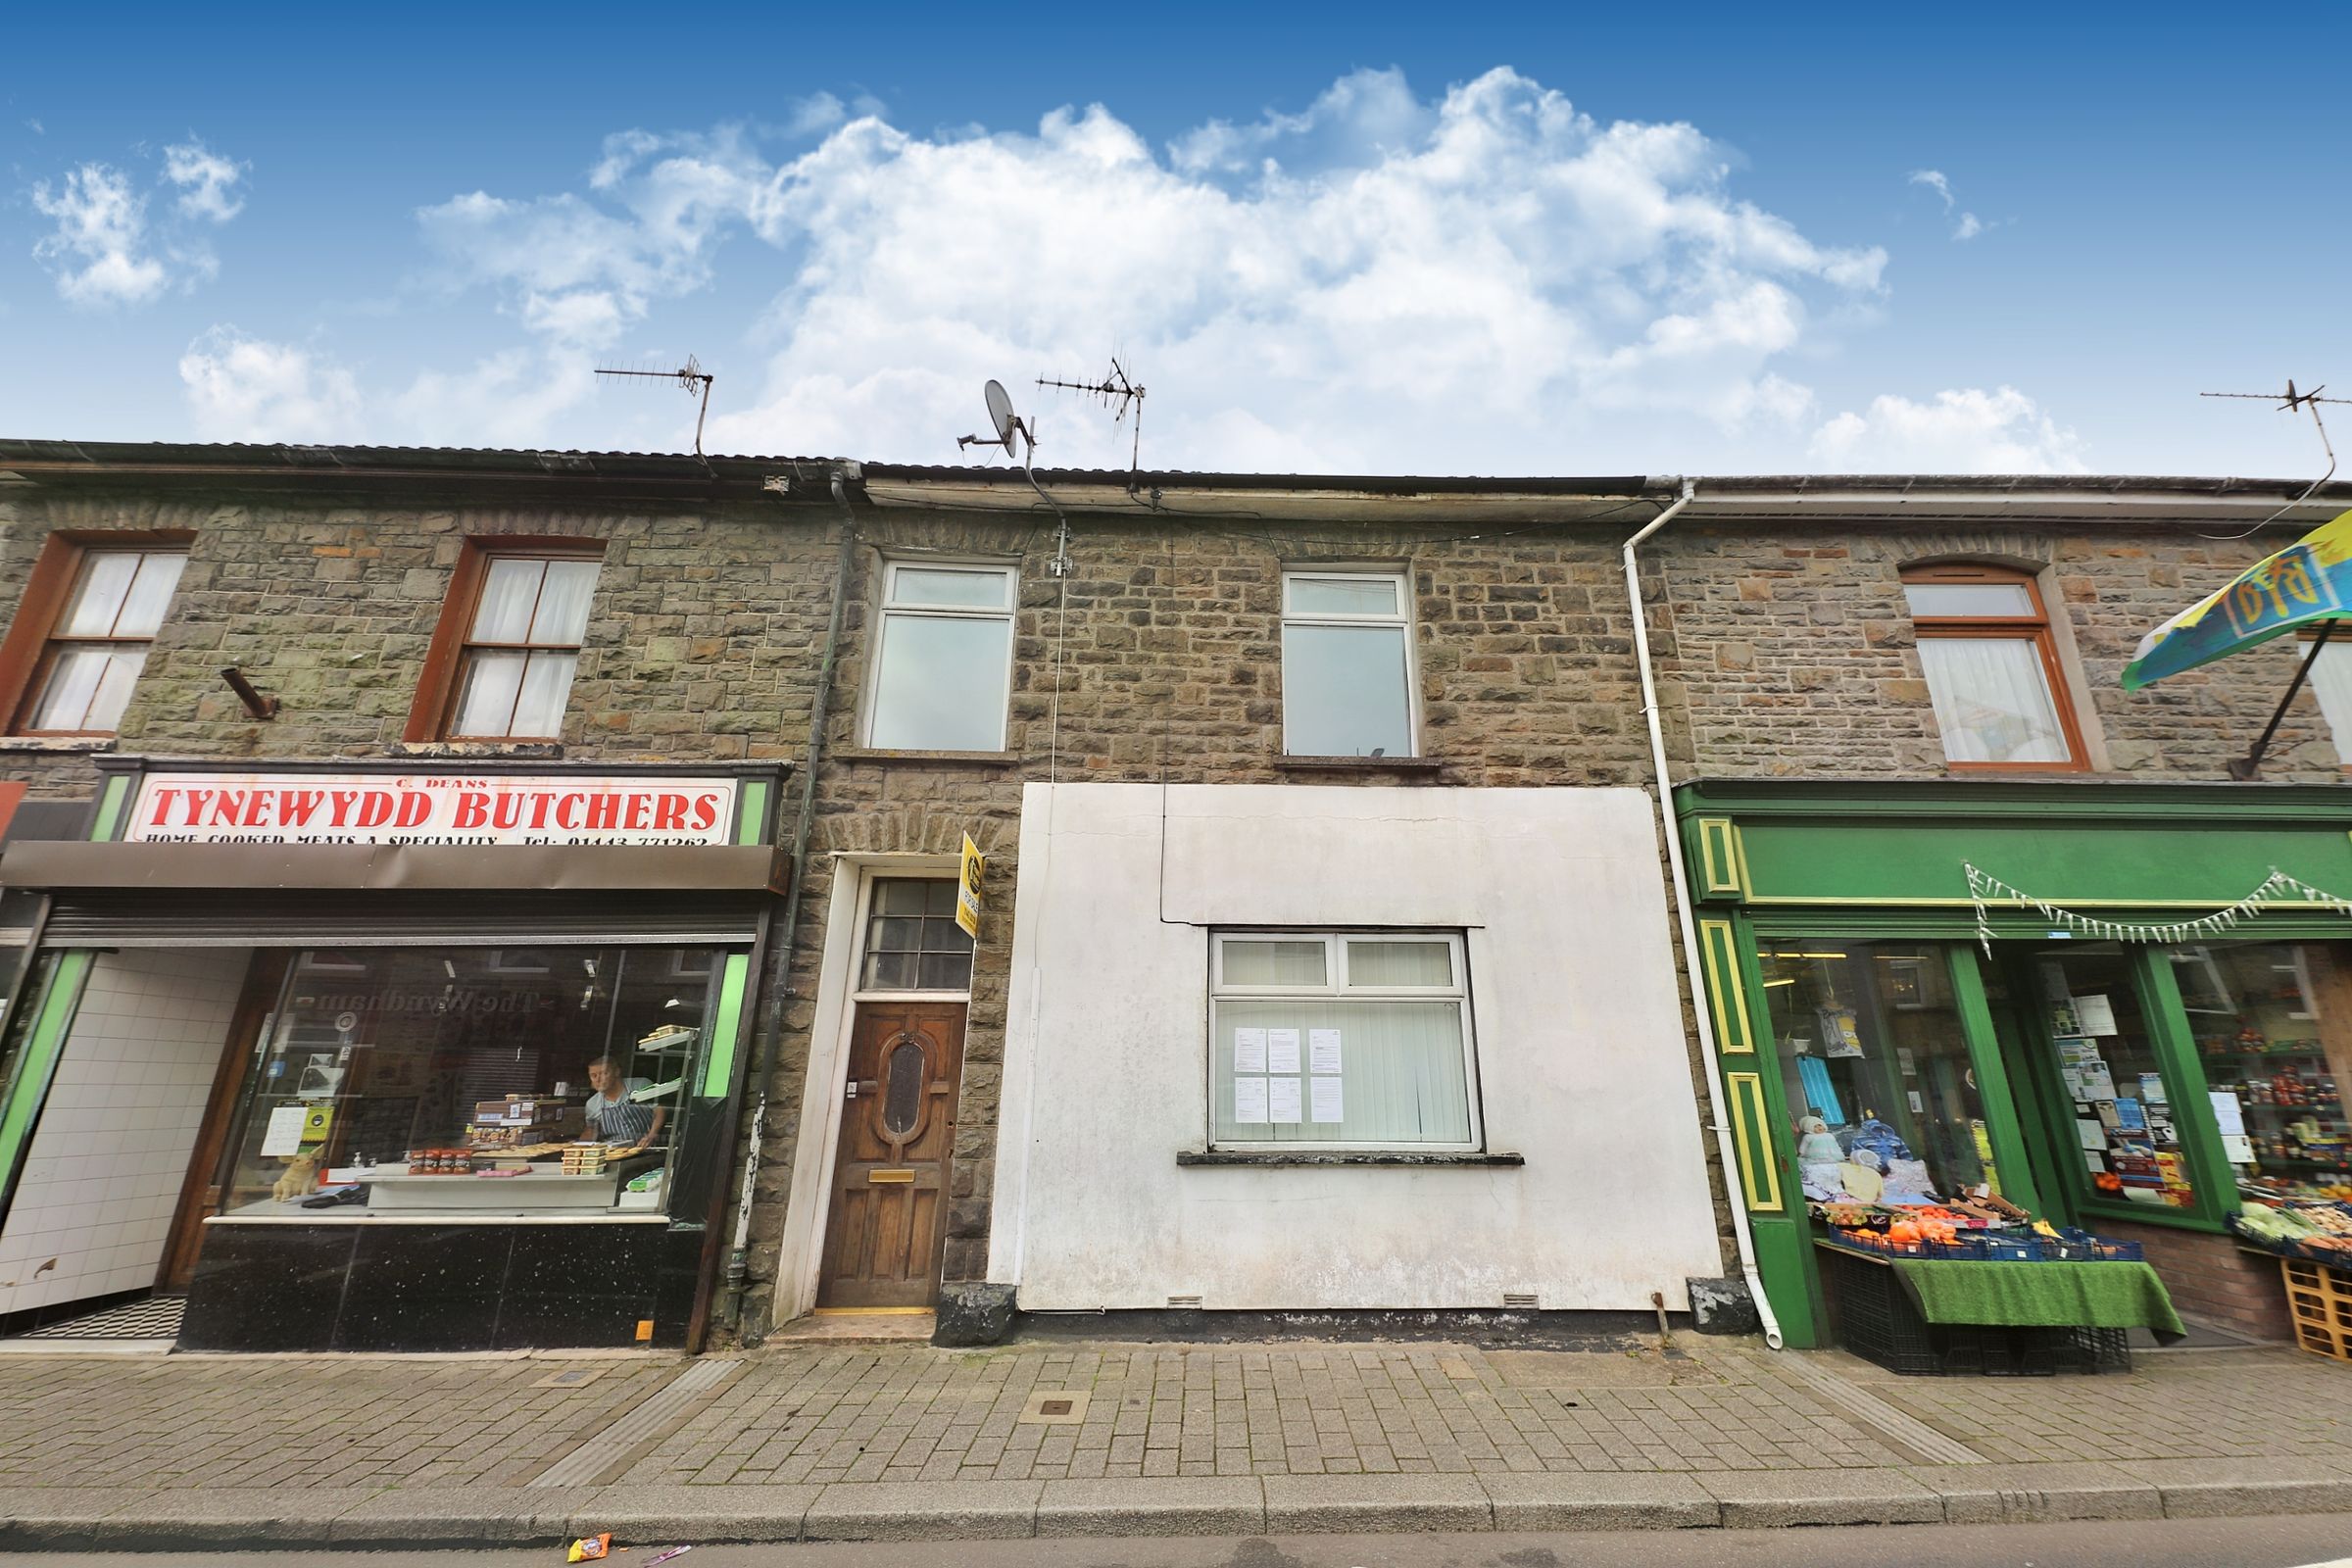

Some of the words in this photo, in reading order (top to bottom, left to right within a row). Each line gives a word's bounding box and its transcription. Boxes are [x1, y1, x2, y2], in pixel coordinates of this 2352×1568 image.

[425, 779, 488, 788] DEANS
[149, 789, 432, 827] TYNEWYDD
[451, 792, 719, 830] BUTCHERS
